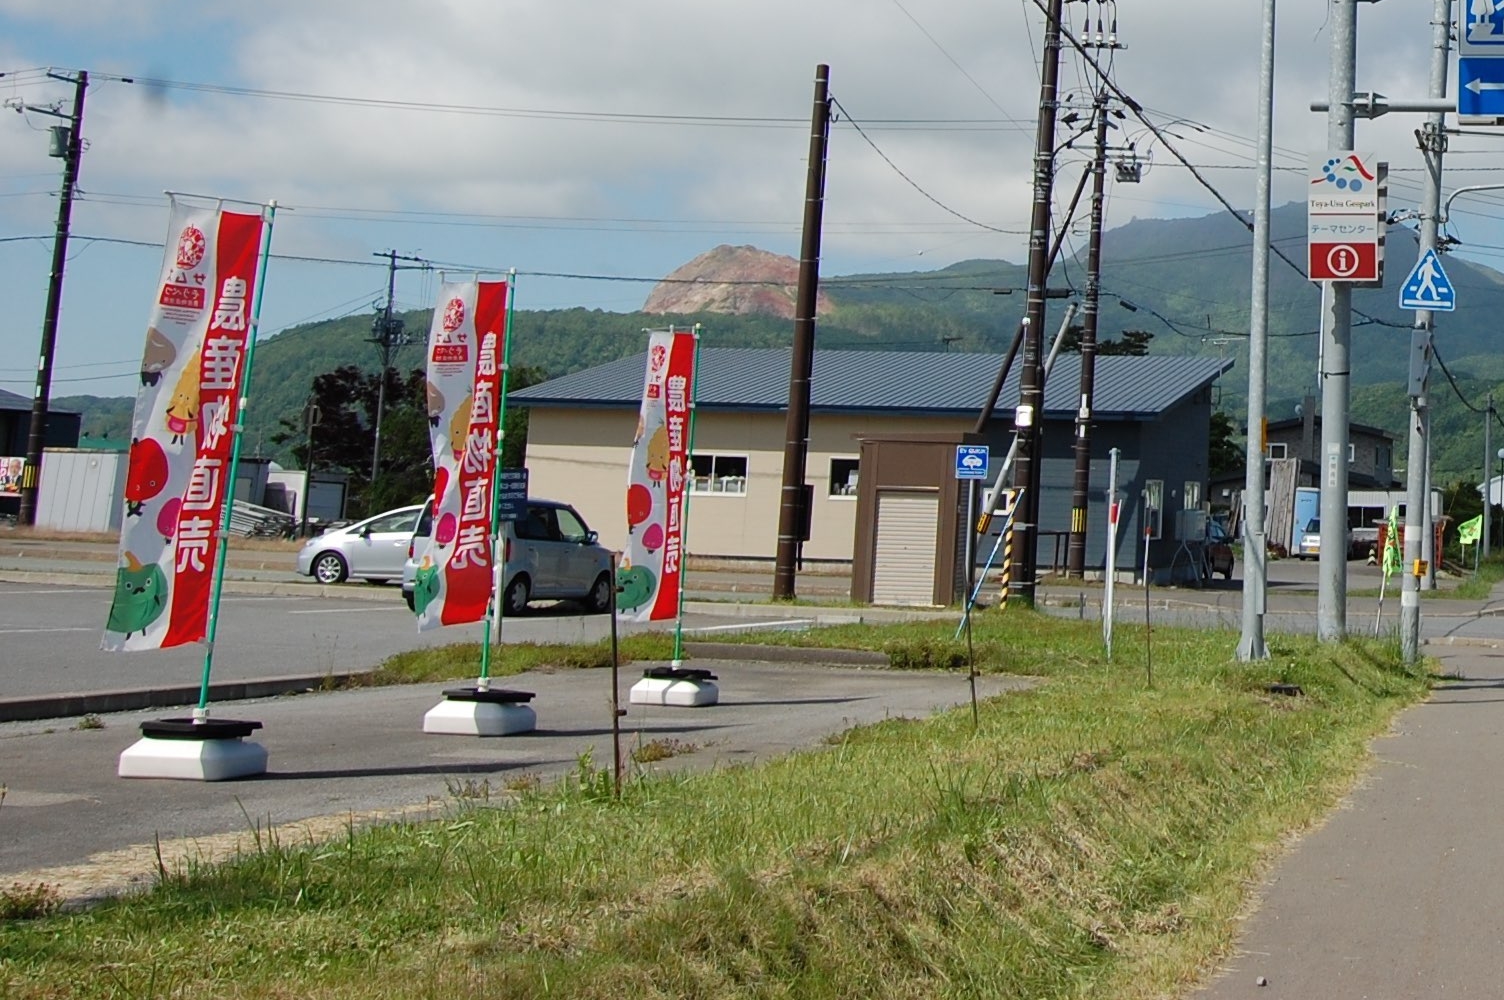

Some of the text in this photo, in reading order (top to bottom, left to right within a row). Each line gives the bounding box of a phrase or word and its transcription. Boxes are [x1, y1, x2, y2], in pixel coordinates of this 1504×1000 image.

[1311, 224, 1375, 234] テーマセンター
